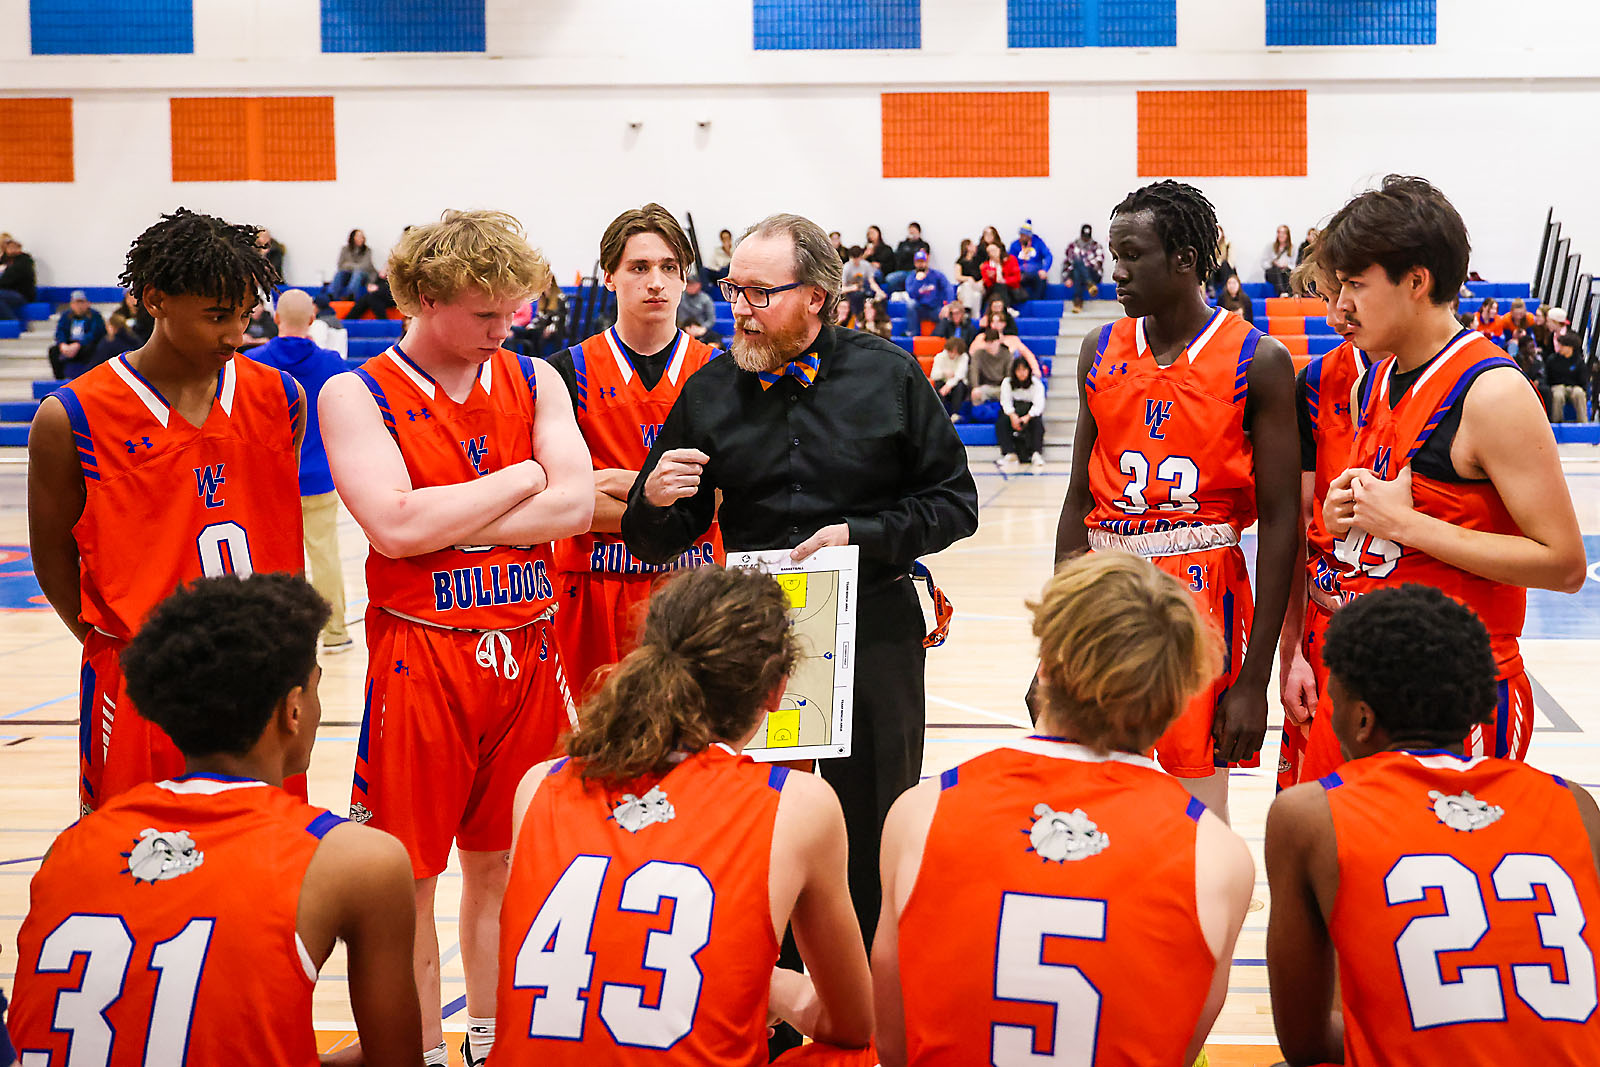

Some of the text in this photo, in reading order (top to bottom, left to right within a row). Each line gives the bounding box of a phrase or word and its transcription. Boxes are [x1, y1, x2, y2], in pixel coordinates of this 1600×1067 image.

[1112, 450, 1200, 515] 33
[432, 560, 553, 612] BULLDOGS
[21, 911, 217, 1067] 31
[513, 853, 716, 1052] 43
[990, 891, 1108, 1067] 5
[1383, 853, 1599, 1032] 23
